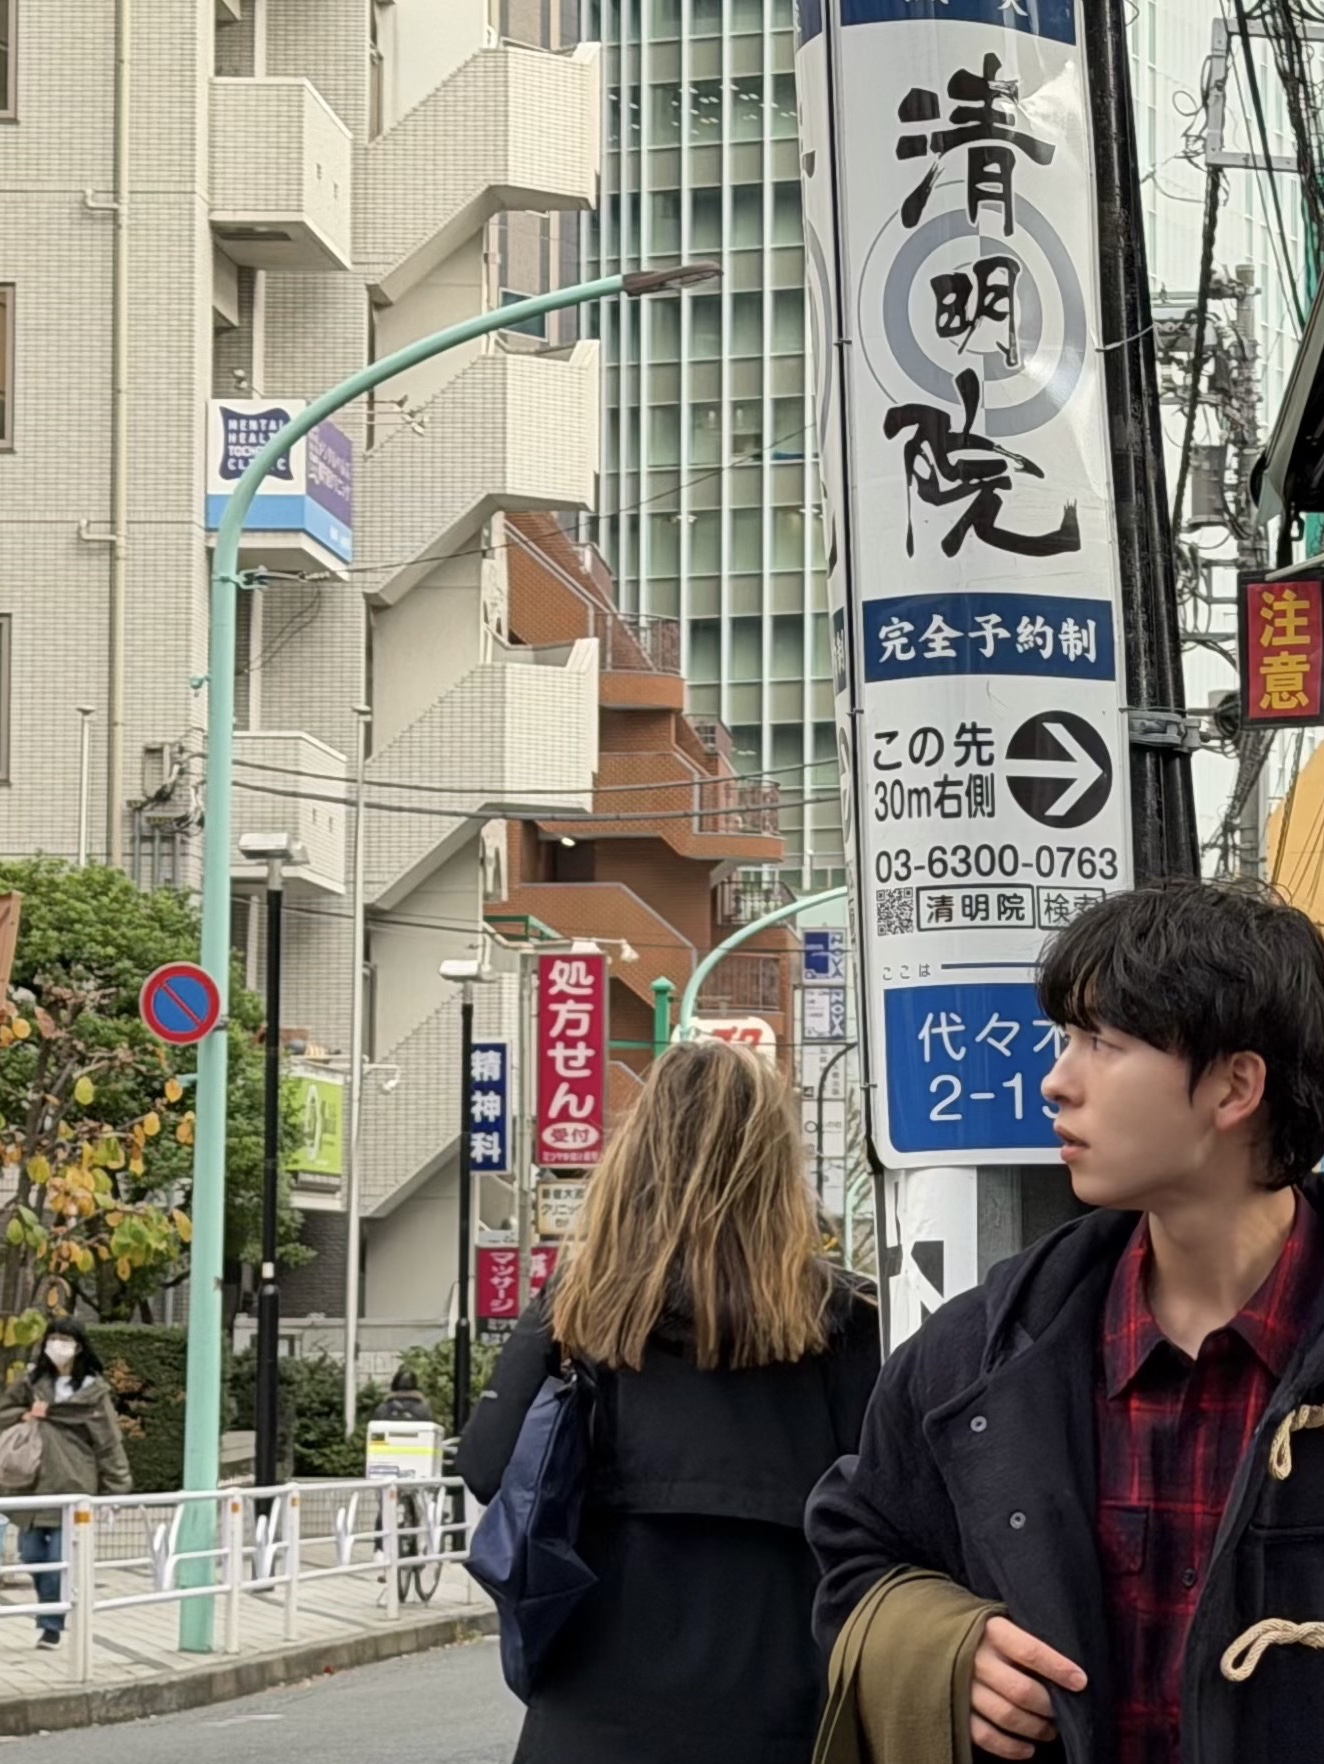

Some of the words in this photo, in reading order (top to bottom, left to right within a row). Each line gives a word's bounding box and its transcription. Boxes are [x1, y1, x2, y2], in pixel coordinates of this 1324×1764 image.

[883, 52, 1081, 558] 清明院
[228, 433, 277, 444] HEAL
[227, 459, 287, 470] CLC
[878, 614, 1097, 663] 完全予約制
[1259, 589, 1311, 710] 注意
[873, 722, 996, 771] この先
[874, 773, 996, 822] 30m右側
[875, 844, 1118, 883] 03-6300-0763
[926, 892, 1026, 923] 清明院
[831, 934, 844, 978] NOVA
[882, 963, 932, 981] ここは
[831, 990, 845, 1037] NOVA
[547, 959, 597, 1119] 処方せん
[470, 1049, 502, 1164] 精神科
[929, 1072, 1060, 1121] 2-1
[550, 1127, 591, 1144] 受付
